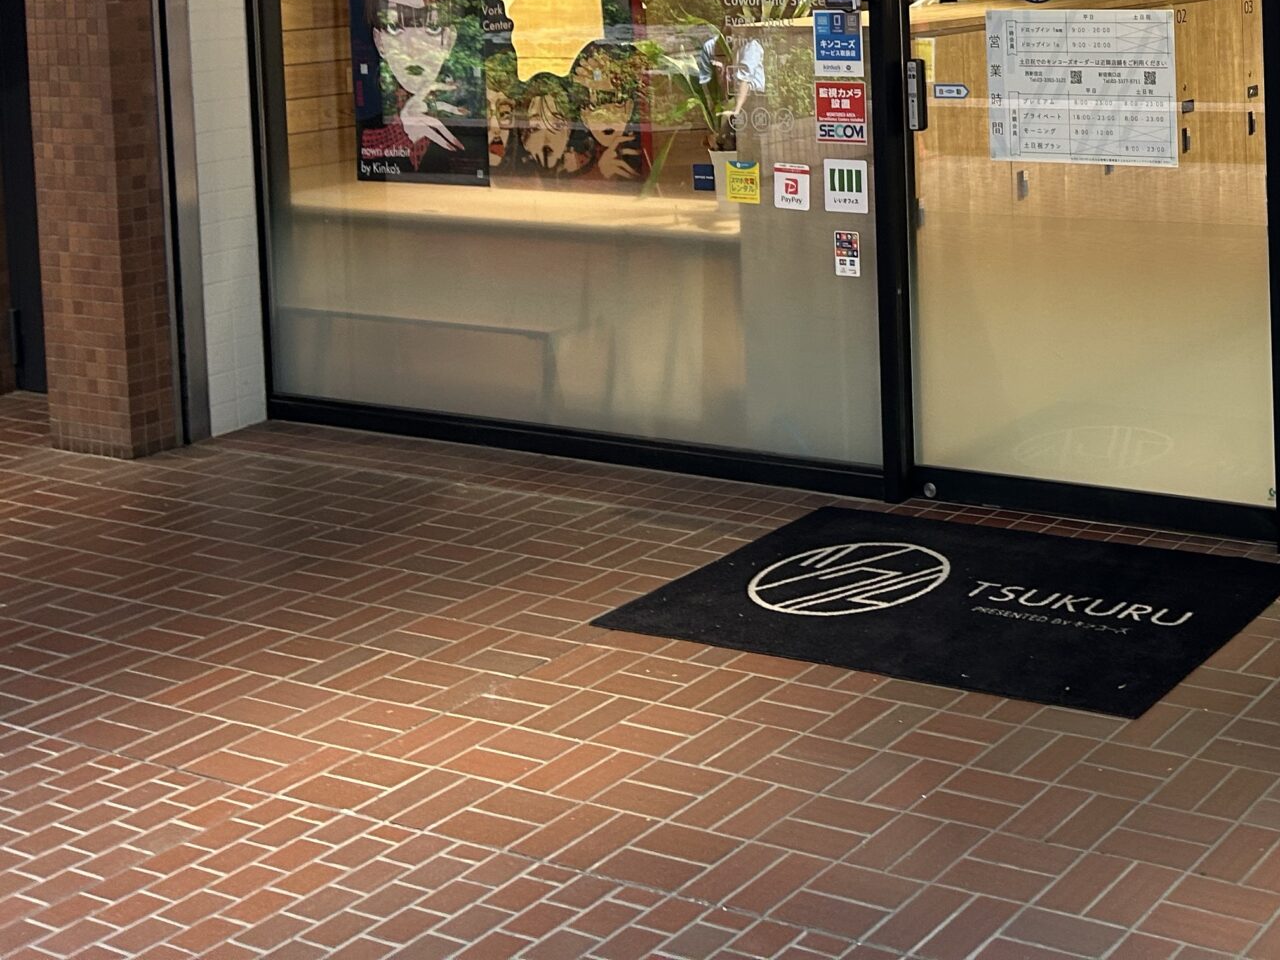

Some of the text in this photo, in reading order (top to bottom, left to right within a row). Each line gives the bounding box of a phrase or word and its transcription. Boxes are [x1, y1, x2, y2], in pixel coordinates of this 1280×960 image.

[1244, 2, 1254, 15] 03
[1176, 8, 1188, 24] 02
[482, 21, 512, 32] Center
[820, 40, 856, 48] キンコーズ
[818, 88, 862, 98] 監視カメラ
[830, 98, 850, 109] 設置
[1024, 112, 1062, 120] プライベート
[819, 124, 864, 138] SECOM
[1024, 128, 1056, 136] モーニング
[361, 160, 400, 176] by Kinko's
[731, 184, 755, 192] レンタル
[780, 195, 803, 204] PayPay
[968, 580, 1193, 626] TSUKURU
[971, 606, 1048, 622] PRESENTED
